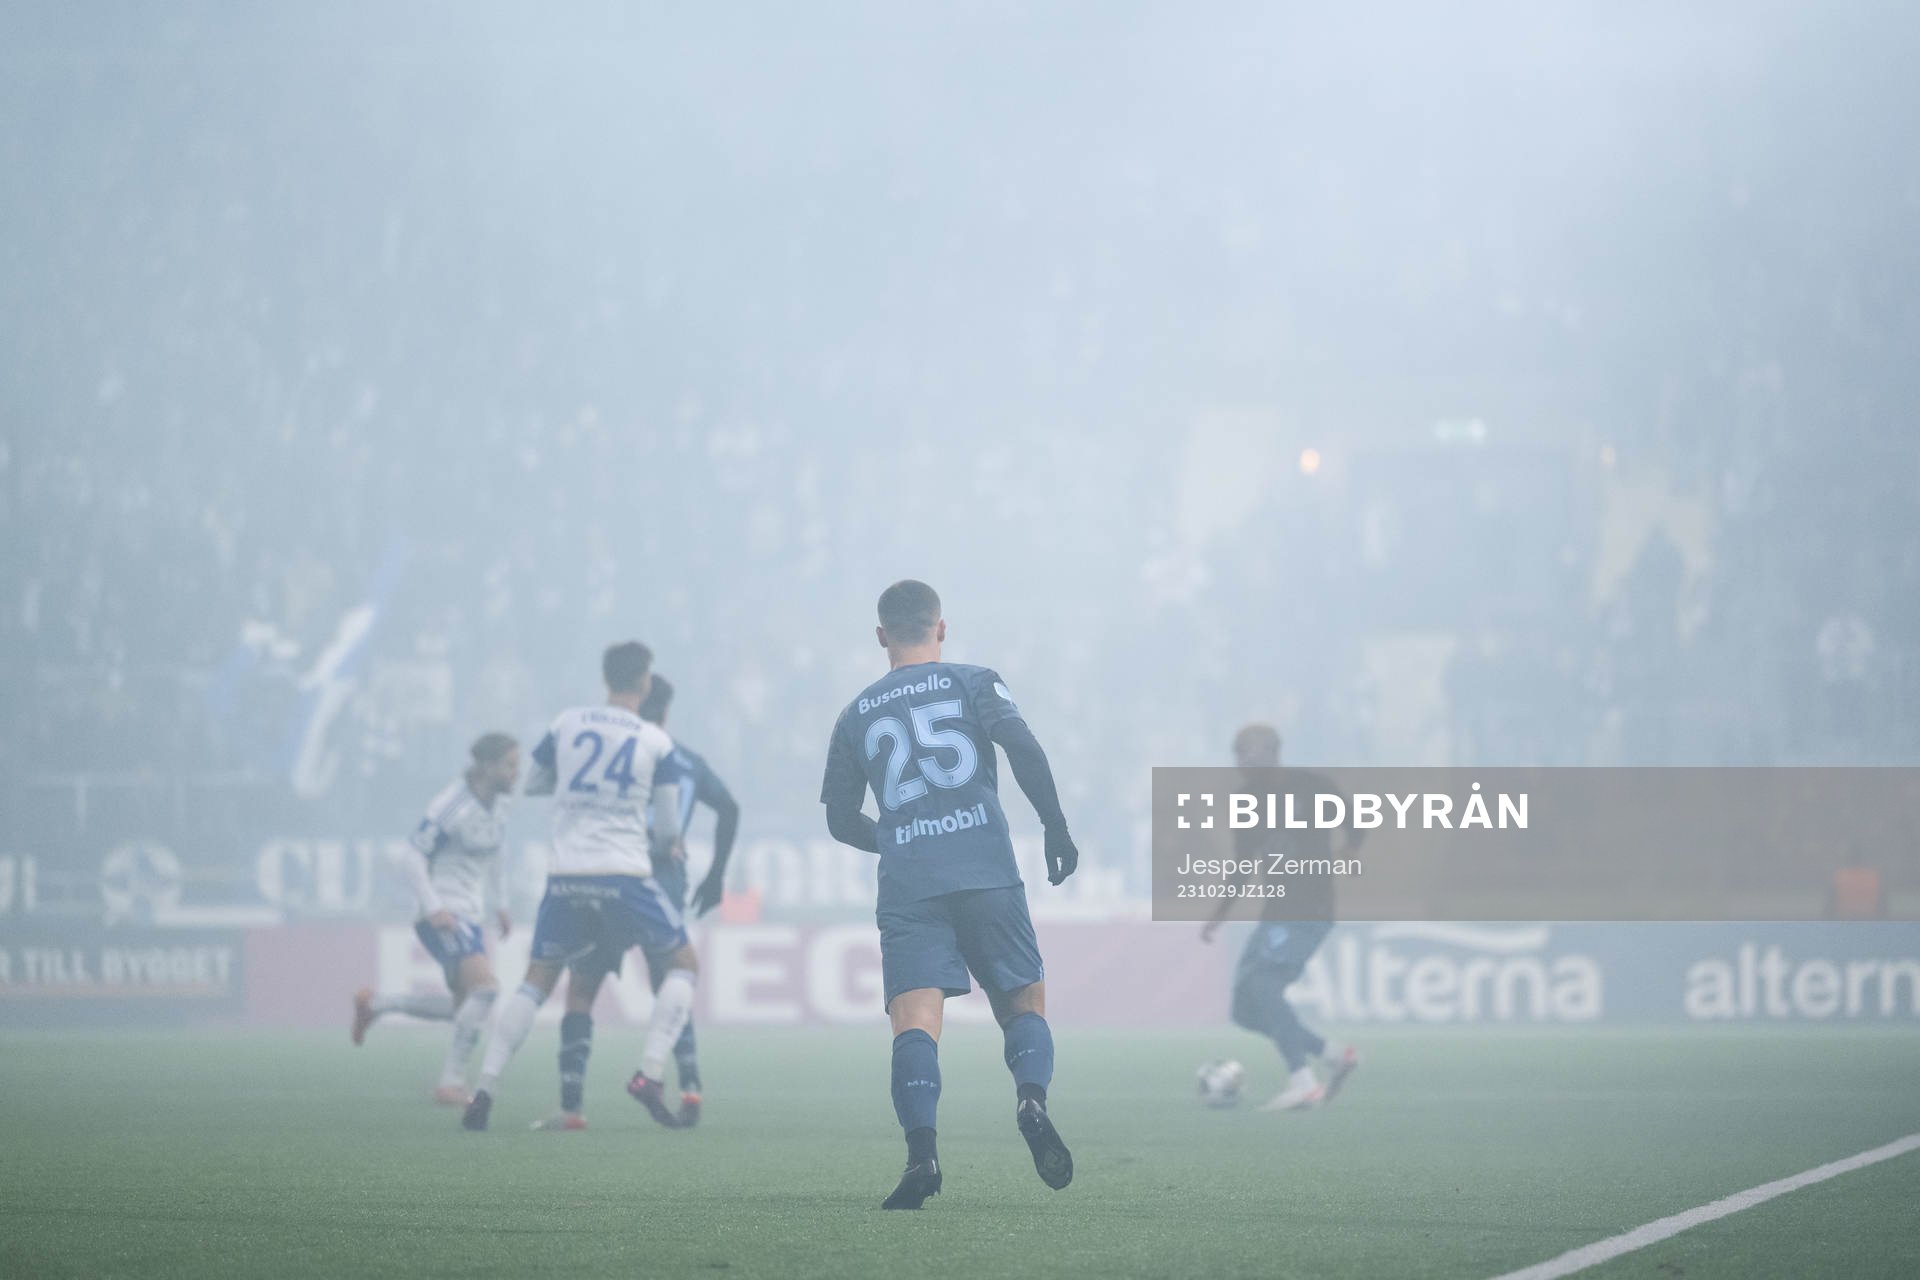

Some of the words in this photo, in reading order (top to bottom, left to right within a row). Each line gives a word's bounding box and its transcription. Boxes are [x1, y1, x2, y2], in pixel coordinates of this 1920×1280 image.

[858, 674, 952, 715] Busanello
[568, 729, 638, 798] 24
[864, 699, 978, 811] 25
[23, 947, 94, 983] TILL
